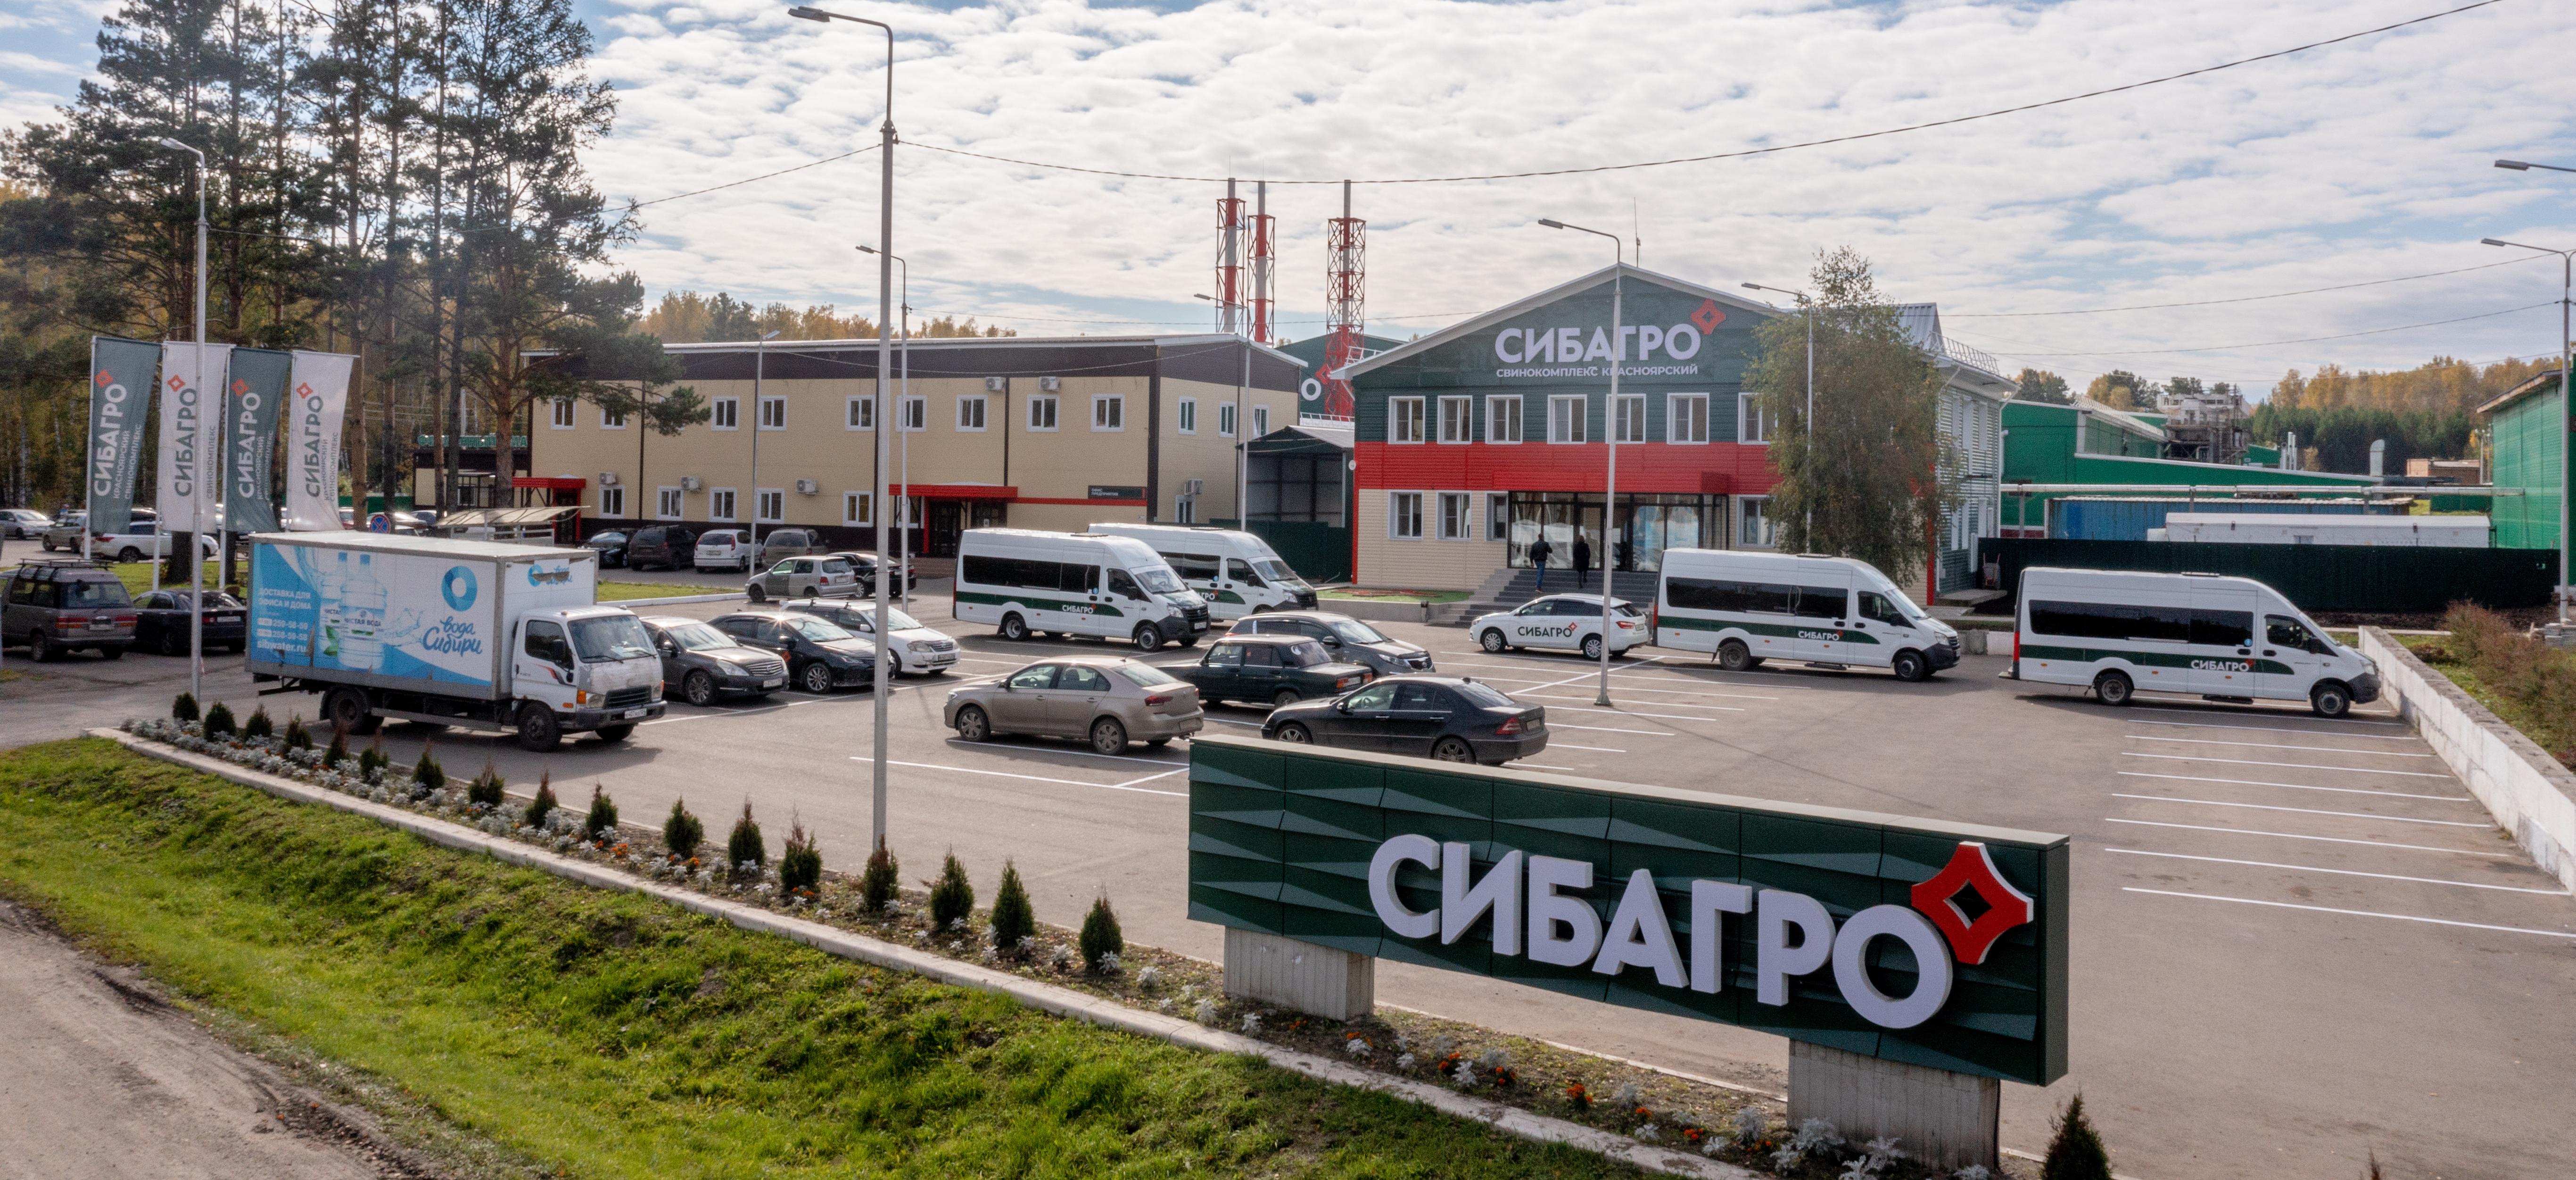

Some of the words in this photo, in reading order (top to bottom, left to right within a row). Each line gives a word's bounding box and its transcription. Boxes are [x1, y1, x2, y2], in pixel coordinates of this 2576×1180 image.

[1495, 324, 1701, 363] СИБАГРО
[1496, 366, 1598, 378] СВИНОКОМПЛЕКС
[94, 383, 127, 497] СИБАГРО
[174, 388, 197, 497] СИБАГРО
[238, 392, 261, 498] СИБАГРО
[304, 396, 324, 498] СИБАГРО
[113, 430, 131, 499] КРАСНОЯРСКИЙ
[124, 424, 141, 500] СВИНОКОМПЛЕКС
[206, 426, 216, 499] СВИНОКОМПЛЕКС
[330, 432, 339, 502] СВИНОКОМПЛЕКС
[258, 588, 294, 598] ДОСТАВКА
[295, 591, 311, 599] ДЛЯ
[258, 598, 282, 607] ОФИСА
[290, 601, 312, 610] ДОМА
[1062, 604, 1094, 614] СИБАГРО
[422, 626, 483, 657] Сибири
[439, 616, 476, 639] вода
[1518, 626, 1572, 637] СИБАГРО
[1798, 630, 1840, 641] СИБАГРО
[257, 639, 306, 653] sibwater.ru
[2191, 659, 2249, 672] СИБАГРО
[1369, 834, 1953, 1029] СИБАГРО
